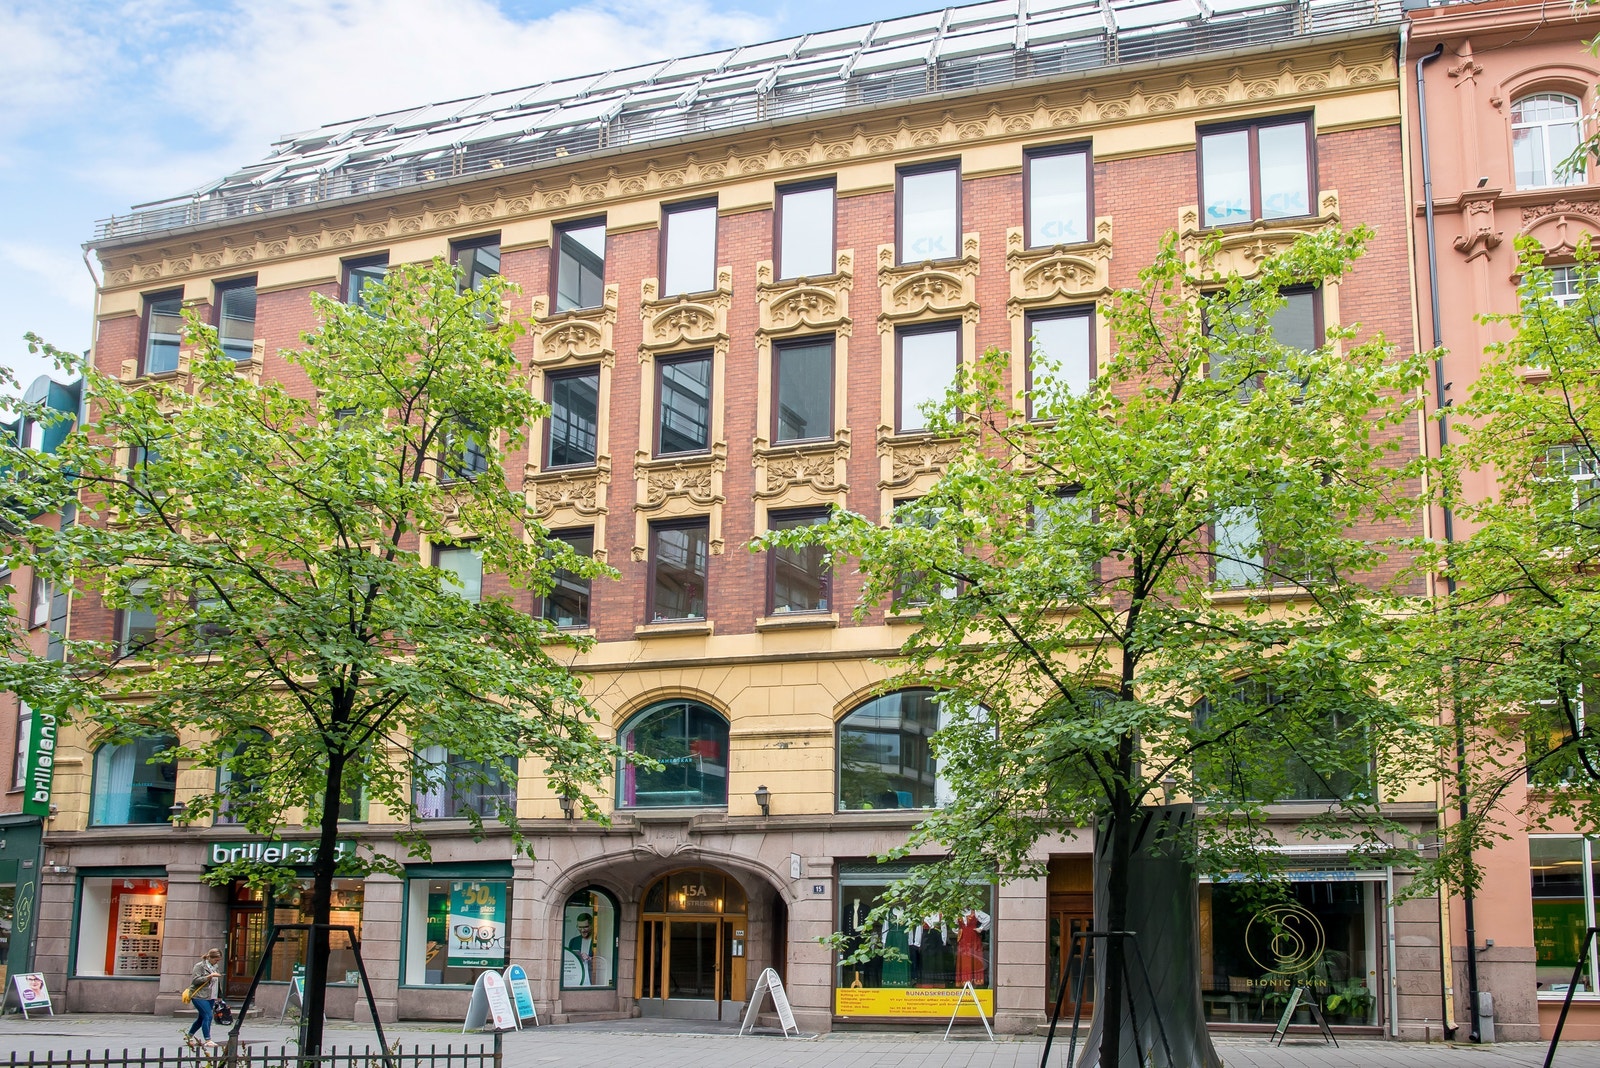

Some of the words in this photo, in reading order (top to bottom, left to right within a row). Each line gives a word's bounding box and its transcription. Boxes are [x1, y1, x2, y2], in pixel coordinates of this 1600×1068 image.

[682, 885, 707, 897] 15A
[461, 904, 469, 912] på
[480, 905, 496, 913] glass
[1246, 979, 1291, 987] BIONIC
[1297, 979, 1327, 987] SKIN
